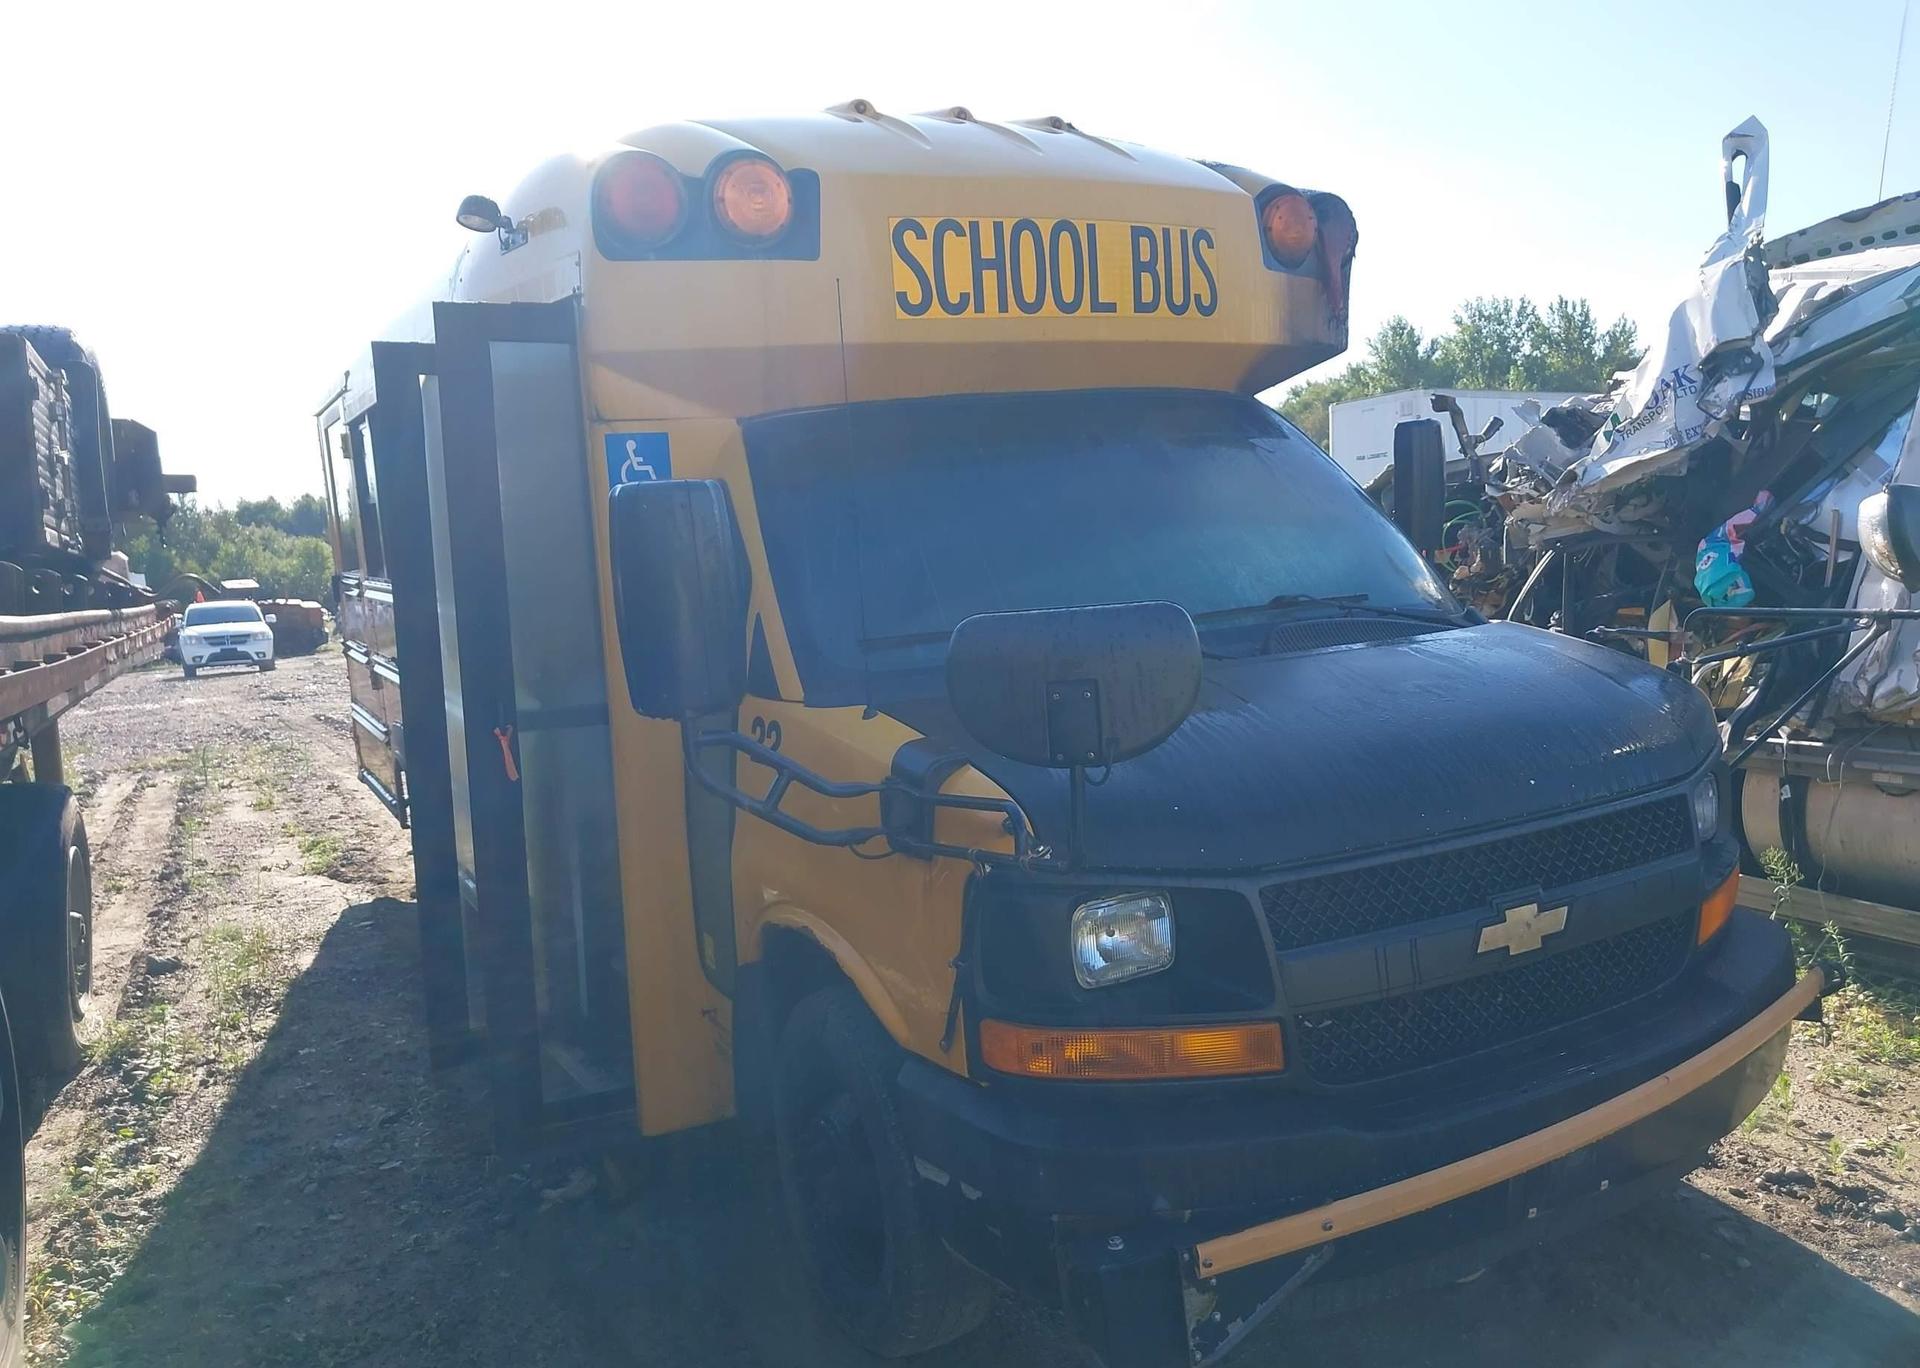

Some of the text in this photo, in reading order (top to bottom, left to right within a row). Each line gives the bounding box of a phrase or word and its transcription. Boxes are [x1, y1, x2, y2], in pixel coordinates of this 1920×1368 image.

[891, 218, 1219, 318] SCHOOL BUS
[1675, 384, 1698, 400] LTD
